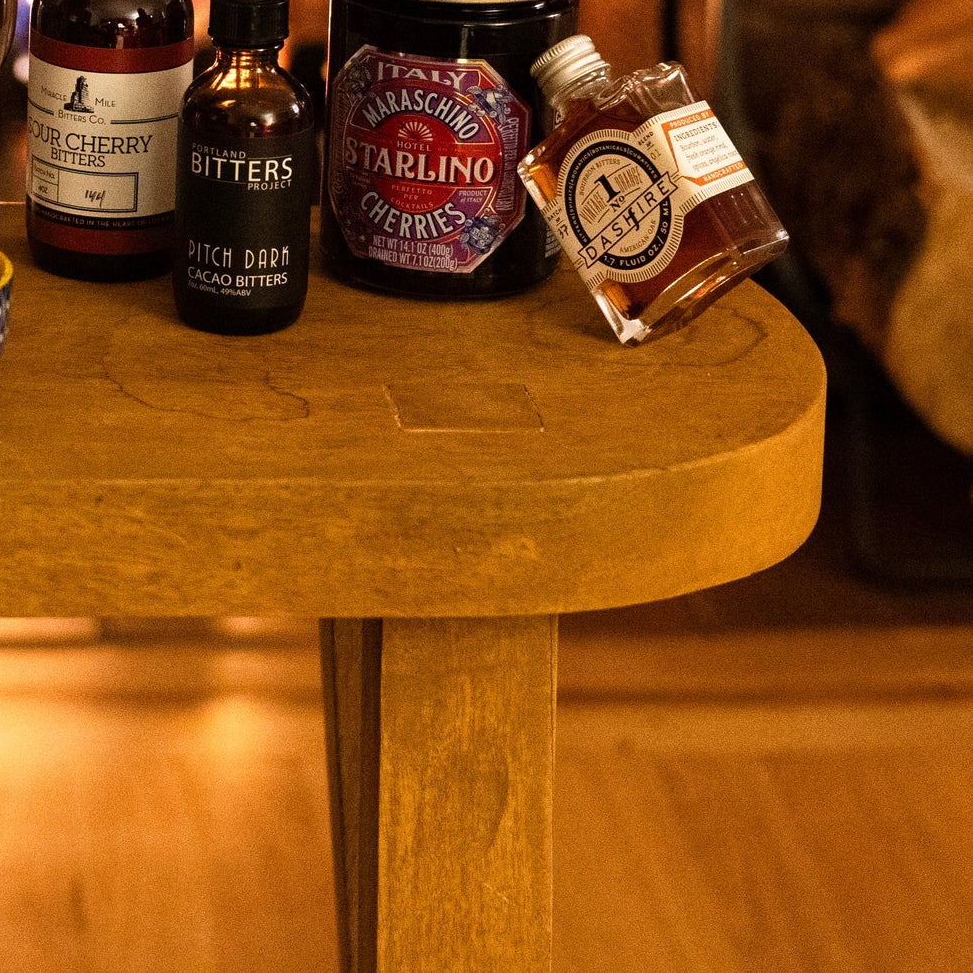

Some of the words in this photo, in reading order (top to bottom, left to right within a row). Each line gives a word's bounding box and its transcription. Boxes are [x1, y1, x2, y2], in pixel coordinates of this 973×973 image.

[377, 61, 468, 91] ITALY
[40, 86, 67, 101] MIRACLE
[94, 97, 116, 108] MILE
[57, 109, 87, 123] BITTERS
[362, 88, 480, 140] MARASCHINO
[669, 114, 701, 128] PRODUCED
[65, 132, 153, 155] CHERRY
[191, 142, 247, 159] PORTLAND
[396, 140, 432, 152] HOTEL
[50, 146, 106, 168] BITTERS
[191, 152, 293, 182] BITTERS
[345, 137, 494, 184] STARLINO
[579, 165, 596, 196] BOURBON
[595, 158, 621, 171] BITTERS
[703, 162, 744, 182] HANDCRAFTED
[247, 179, 292, 191] PROJECT
[391, 184, 433, 195] PERFETTO
[458, 190, 488, 198] PRODUCT
[579, 191, 607, 225] VINTAGE
[614, 165, 643, 193] ORANGE
[390, 197, 434, 211] COCKTAILS
[403, 193, 418, 201] PER
[361, 191, 467, 240] CHERRIES
[662, 200, 669, 216] ML
[619, 234, 649, 254] AMERICAN
[648, 219, 657, 235] OAK
[660, 221, 669, 234] 50
[188, 239, 232, 269] PITCH
[245, 245, 289, 269] DARK
[368, 245, 398, 263] DRAINED
[372, 234, 385, 248] NET
[387, 237, 398, 251] WT
[399, 240, 414, 253] 14.1
[417, 242, 427, 255] OZ
[428, 243, 454, 259] (400g)
[619, 253, 646, 267] FLUID
[187, 266, 232, 287] CACAO
[235, 272, 288, 288] BITTERS
